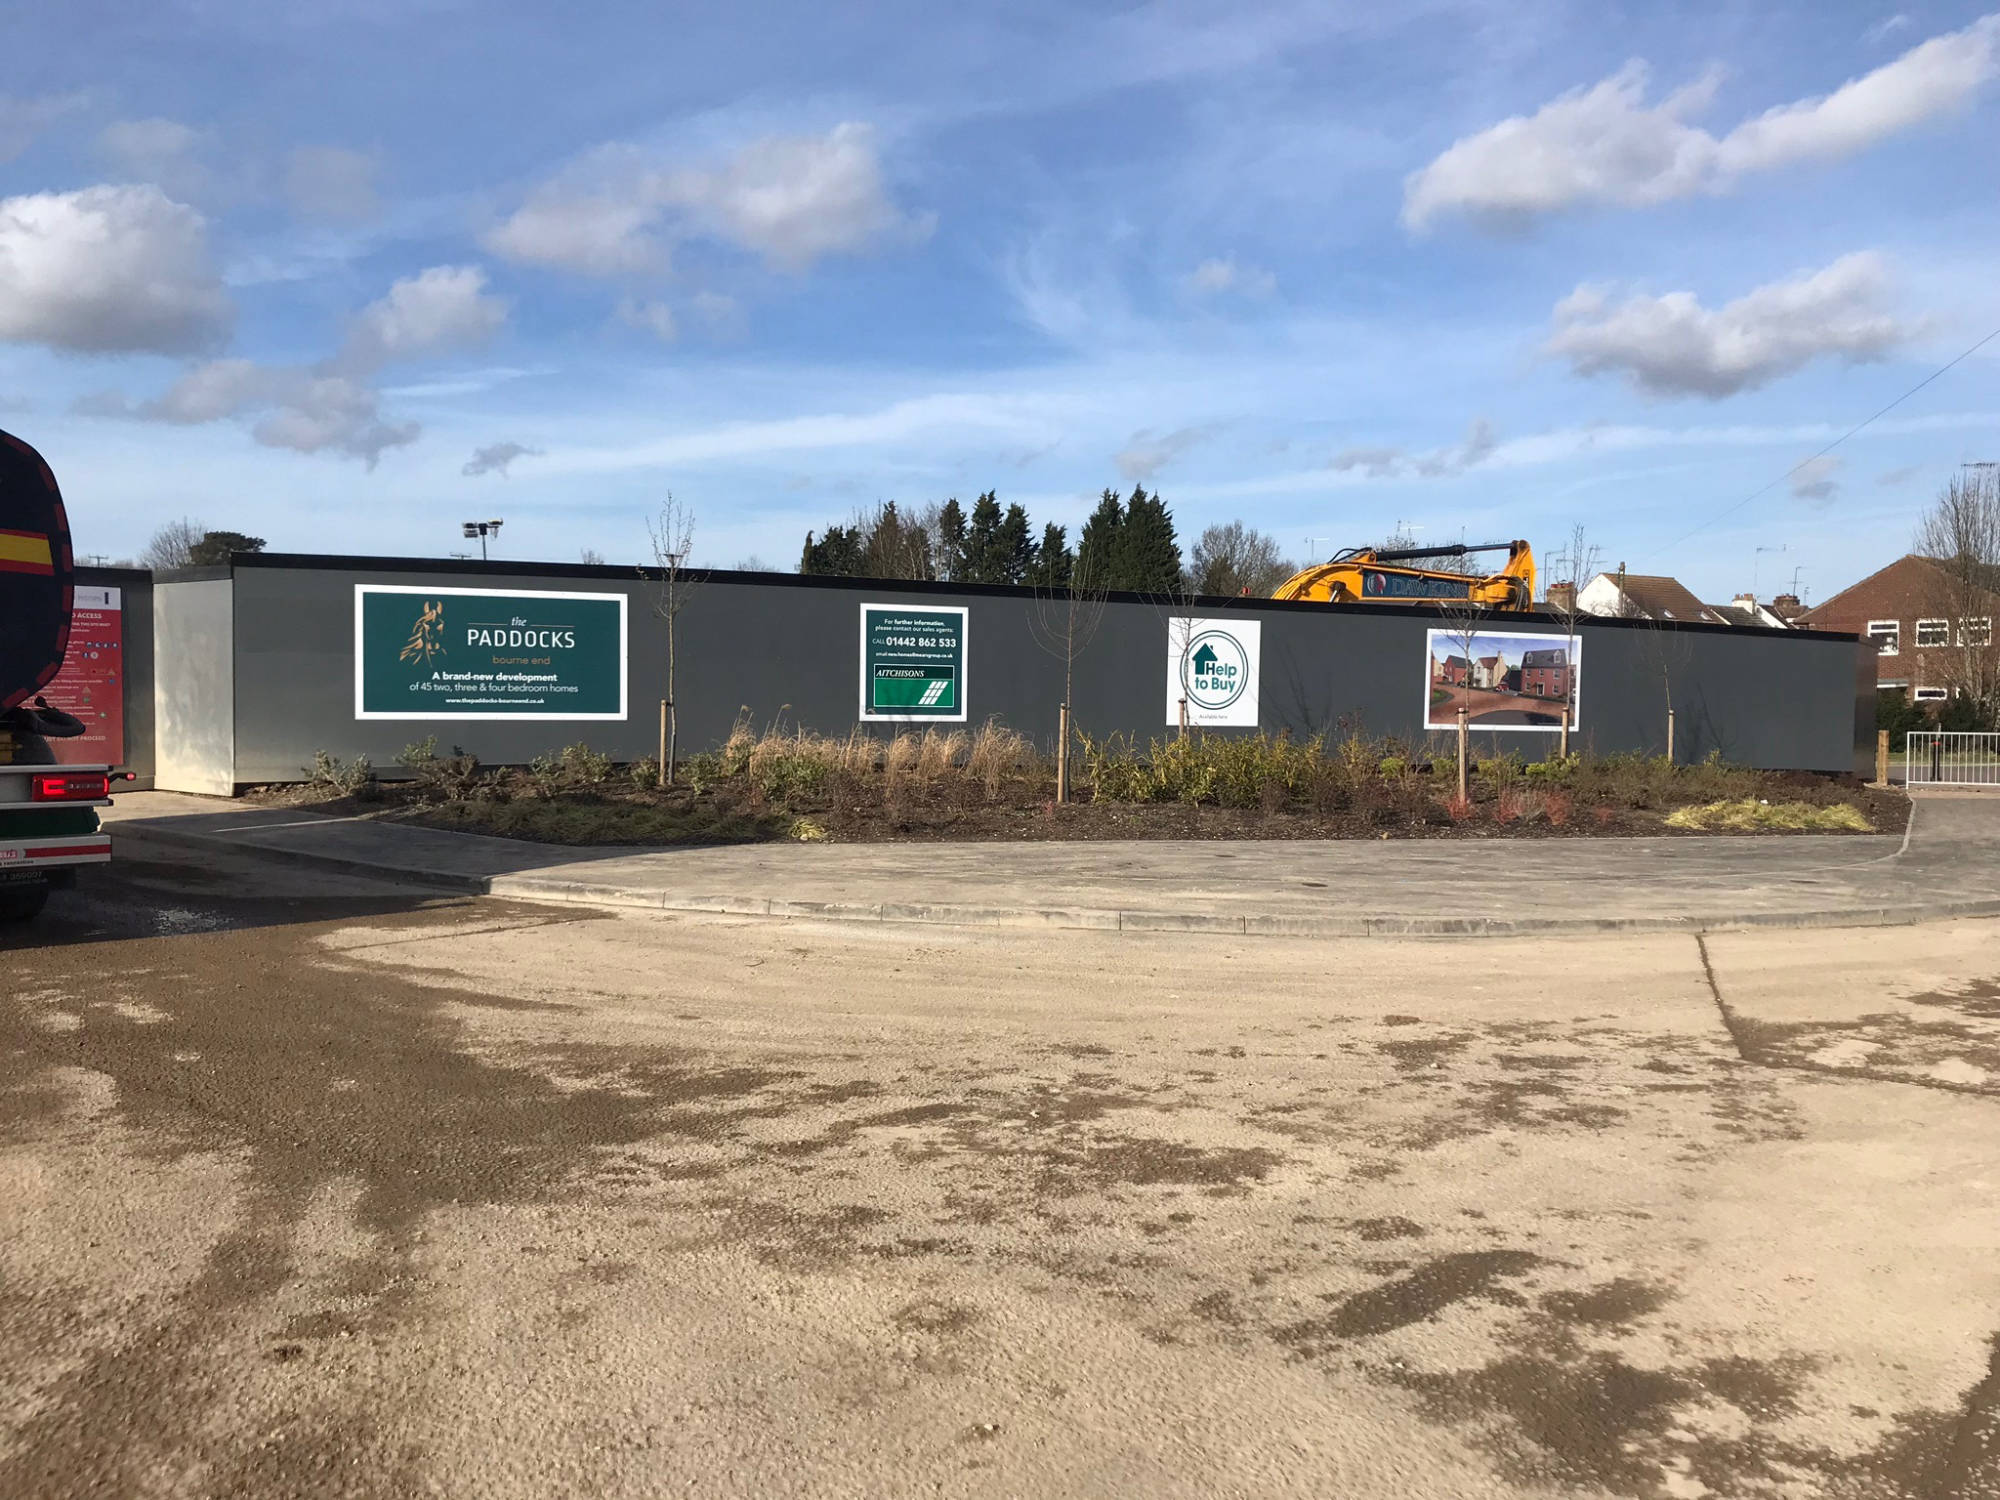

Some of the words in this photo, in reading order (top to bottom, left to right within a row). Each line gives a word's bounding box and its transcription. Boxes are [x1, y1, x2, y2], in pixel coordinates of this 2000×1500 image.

[511, 616, 528, 627] the
[467, 629, 575, 649] PADDOCKS
[885, 636, 916, 647] 01442
[918, 637, 937, 647] 862
[938, 638, 957, 648] 533
[492, 656, 529, 665] bourne
[531, 656, 551, 665] end
[876, 669, 925, 678] AITCHISONS
[1205, 662, 1237, 678] Help
[432, 671, 441, 680] A
[442, 671, 494, 681] brand-new
[495, 672, 558, 684] development
[409, 682, 419, 691] of
[420, 682, 432, 691] 45
[433, 682, 453, 692] two,
[454, 682, 478, 692] three
[479, 682, 487, 692] &
[488, 682, 506, 692] four
[507, 683, 548, 693] bedroom
[549, 683, 579, 693] homes
[1195, 676, 1208, 690] to
[1211, 677, 1236, 693] Buy
